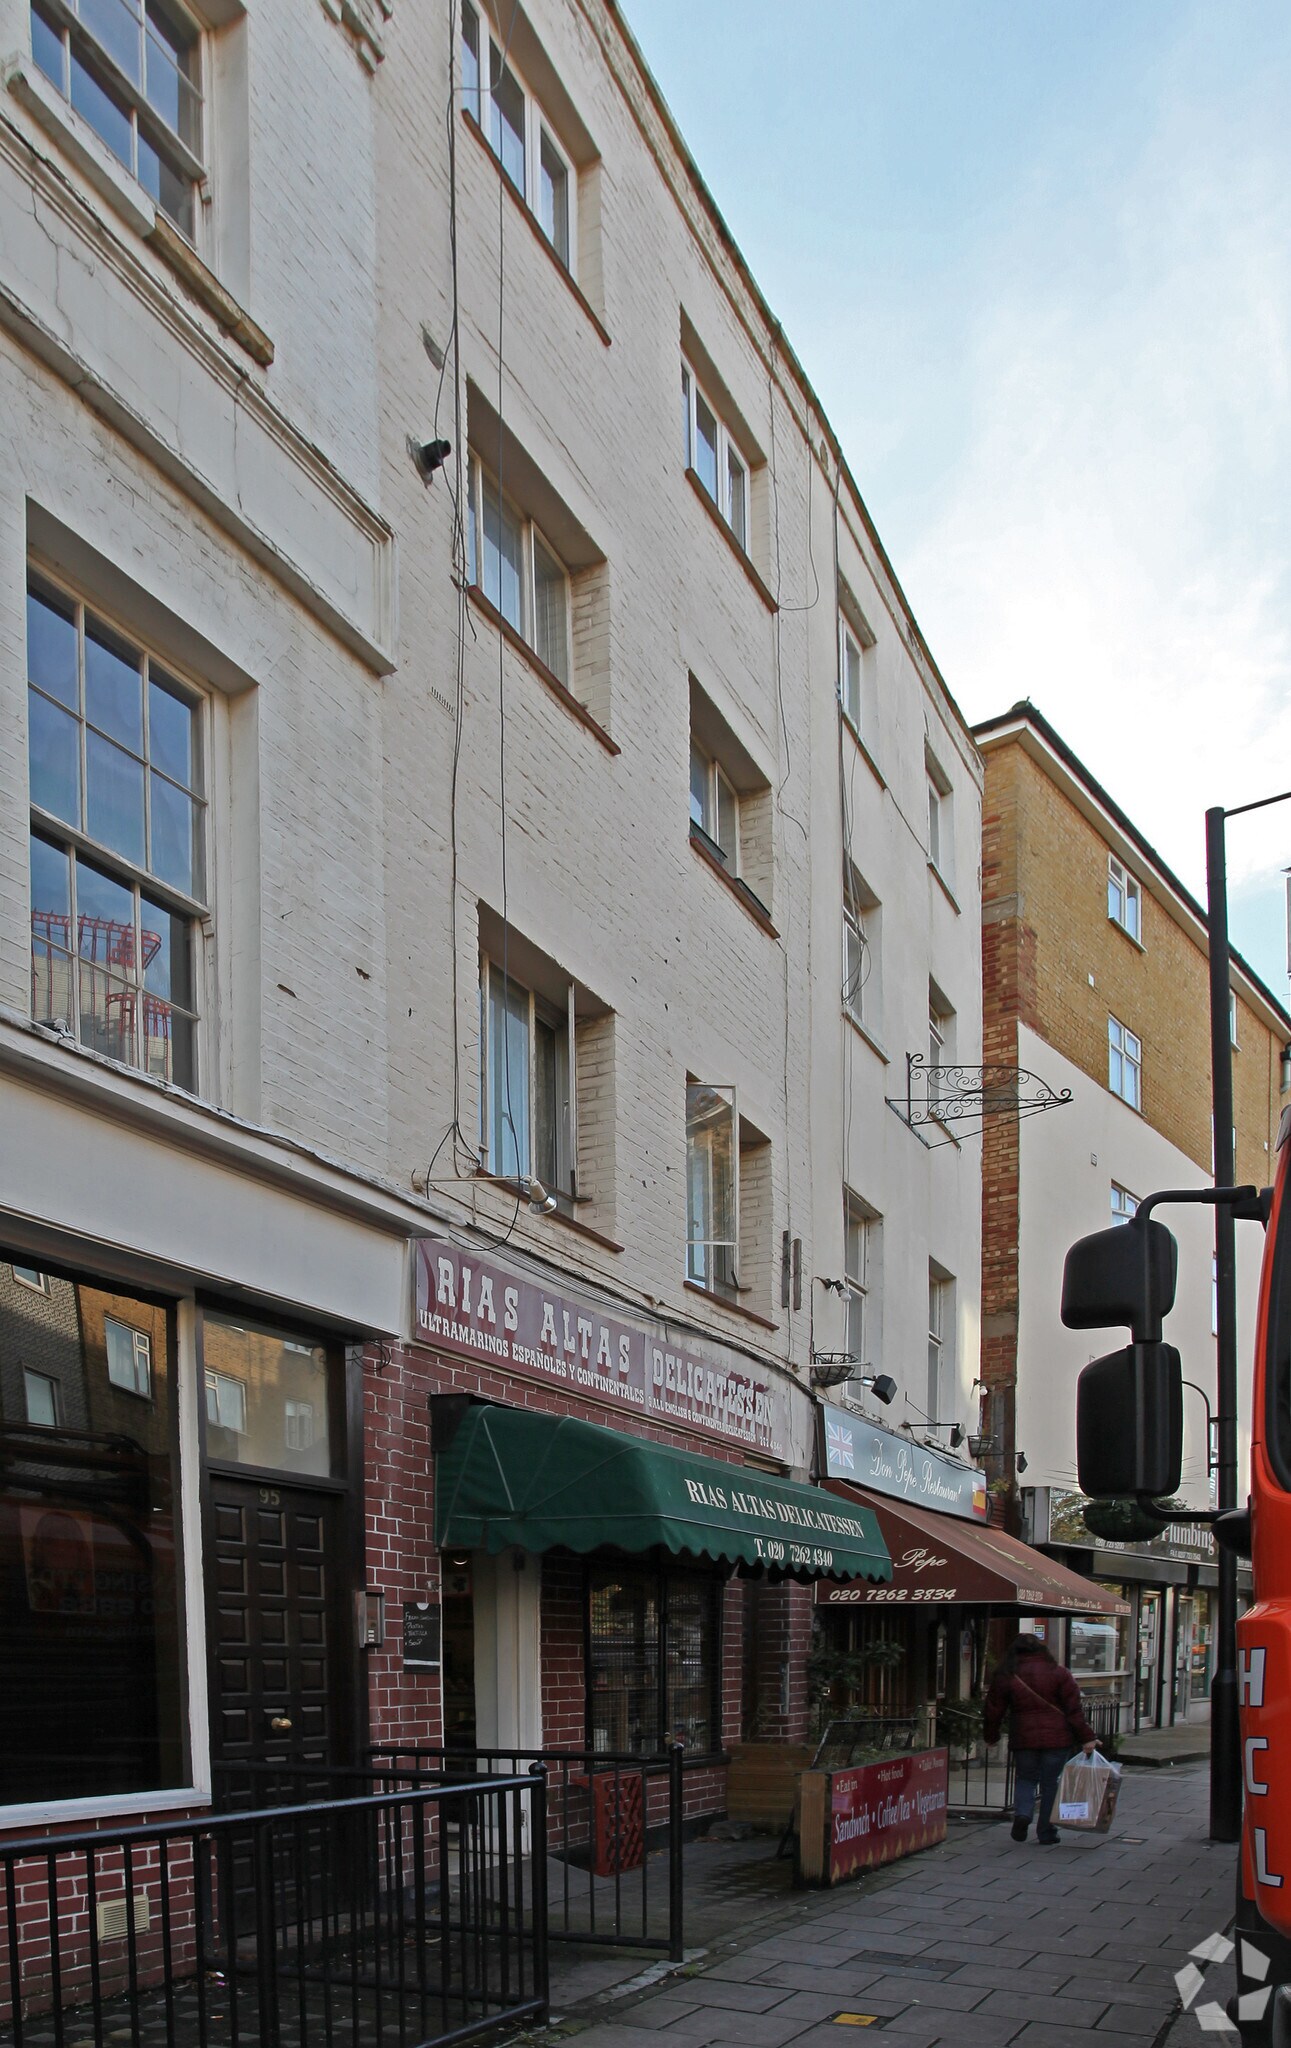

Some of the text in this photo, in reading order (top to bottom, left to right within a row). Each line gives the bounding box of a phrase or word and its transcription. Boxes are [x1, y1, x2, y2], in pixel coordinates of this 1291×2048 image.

[437, 1256, 630, 1373] RIAS ALTAS
[419, 1308, 644, 1405] ULTRAMARINOS ESPAÑOLES Y CONTINENTALES
[869, 1438, 962, 1503] Don Pepe Restaurant
[259, 1487, 281, 1506] 95
[684, 1478, 865, 1539] RIAS ALTAS DELICATESSEN
[753, 1538, 833, 1567] T. 020 7262 4340
[893, 1548, 948, 1573] Pepe
[829, 1588, 957, 1601] 020 7262 3834
[834, 1803, 871, 1845] Sandwich
